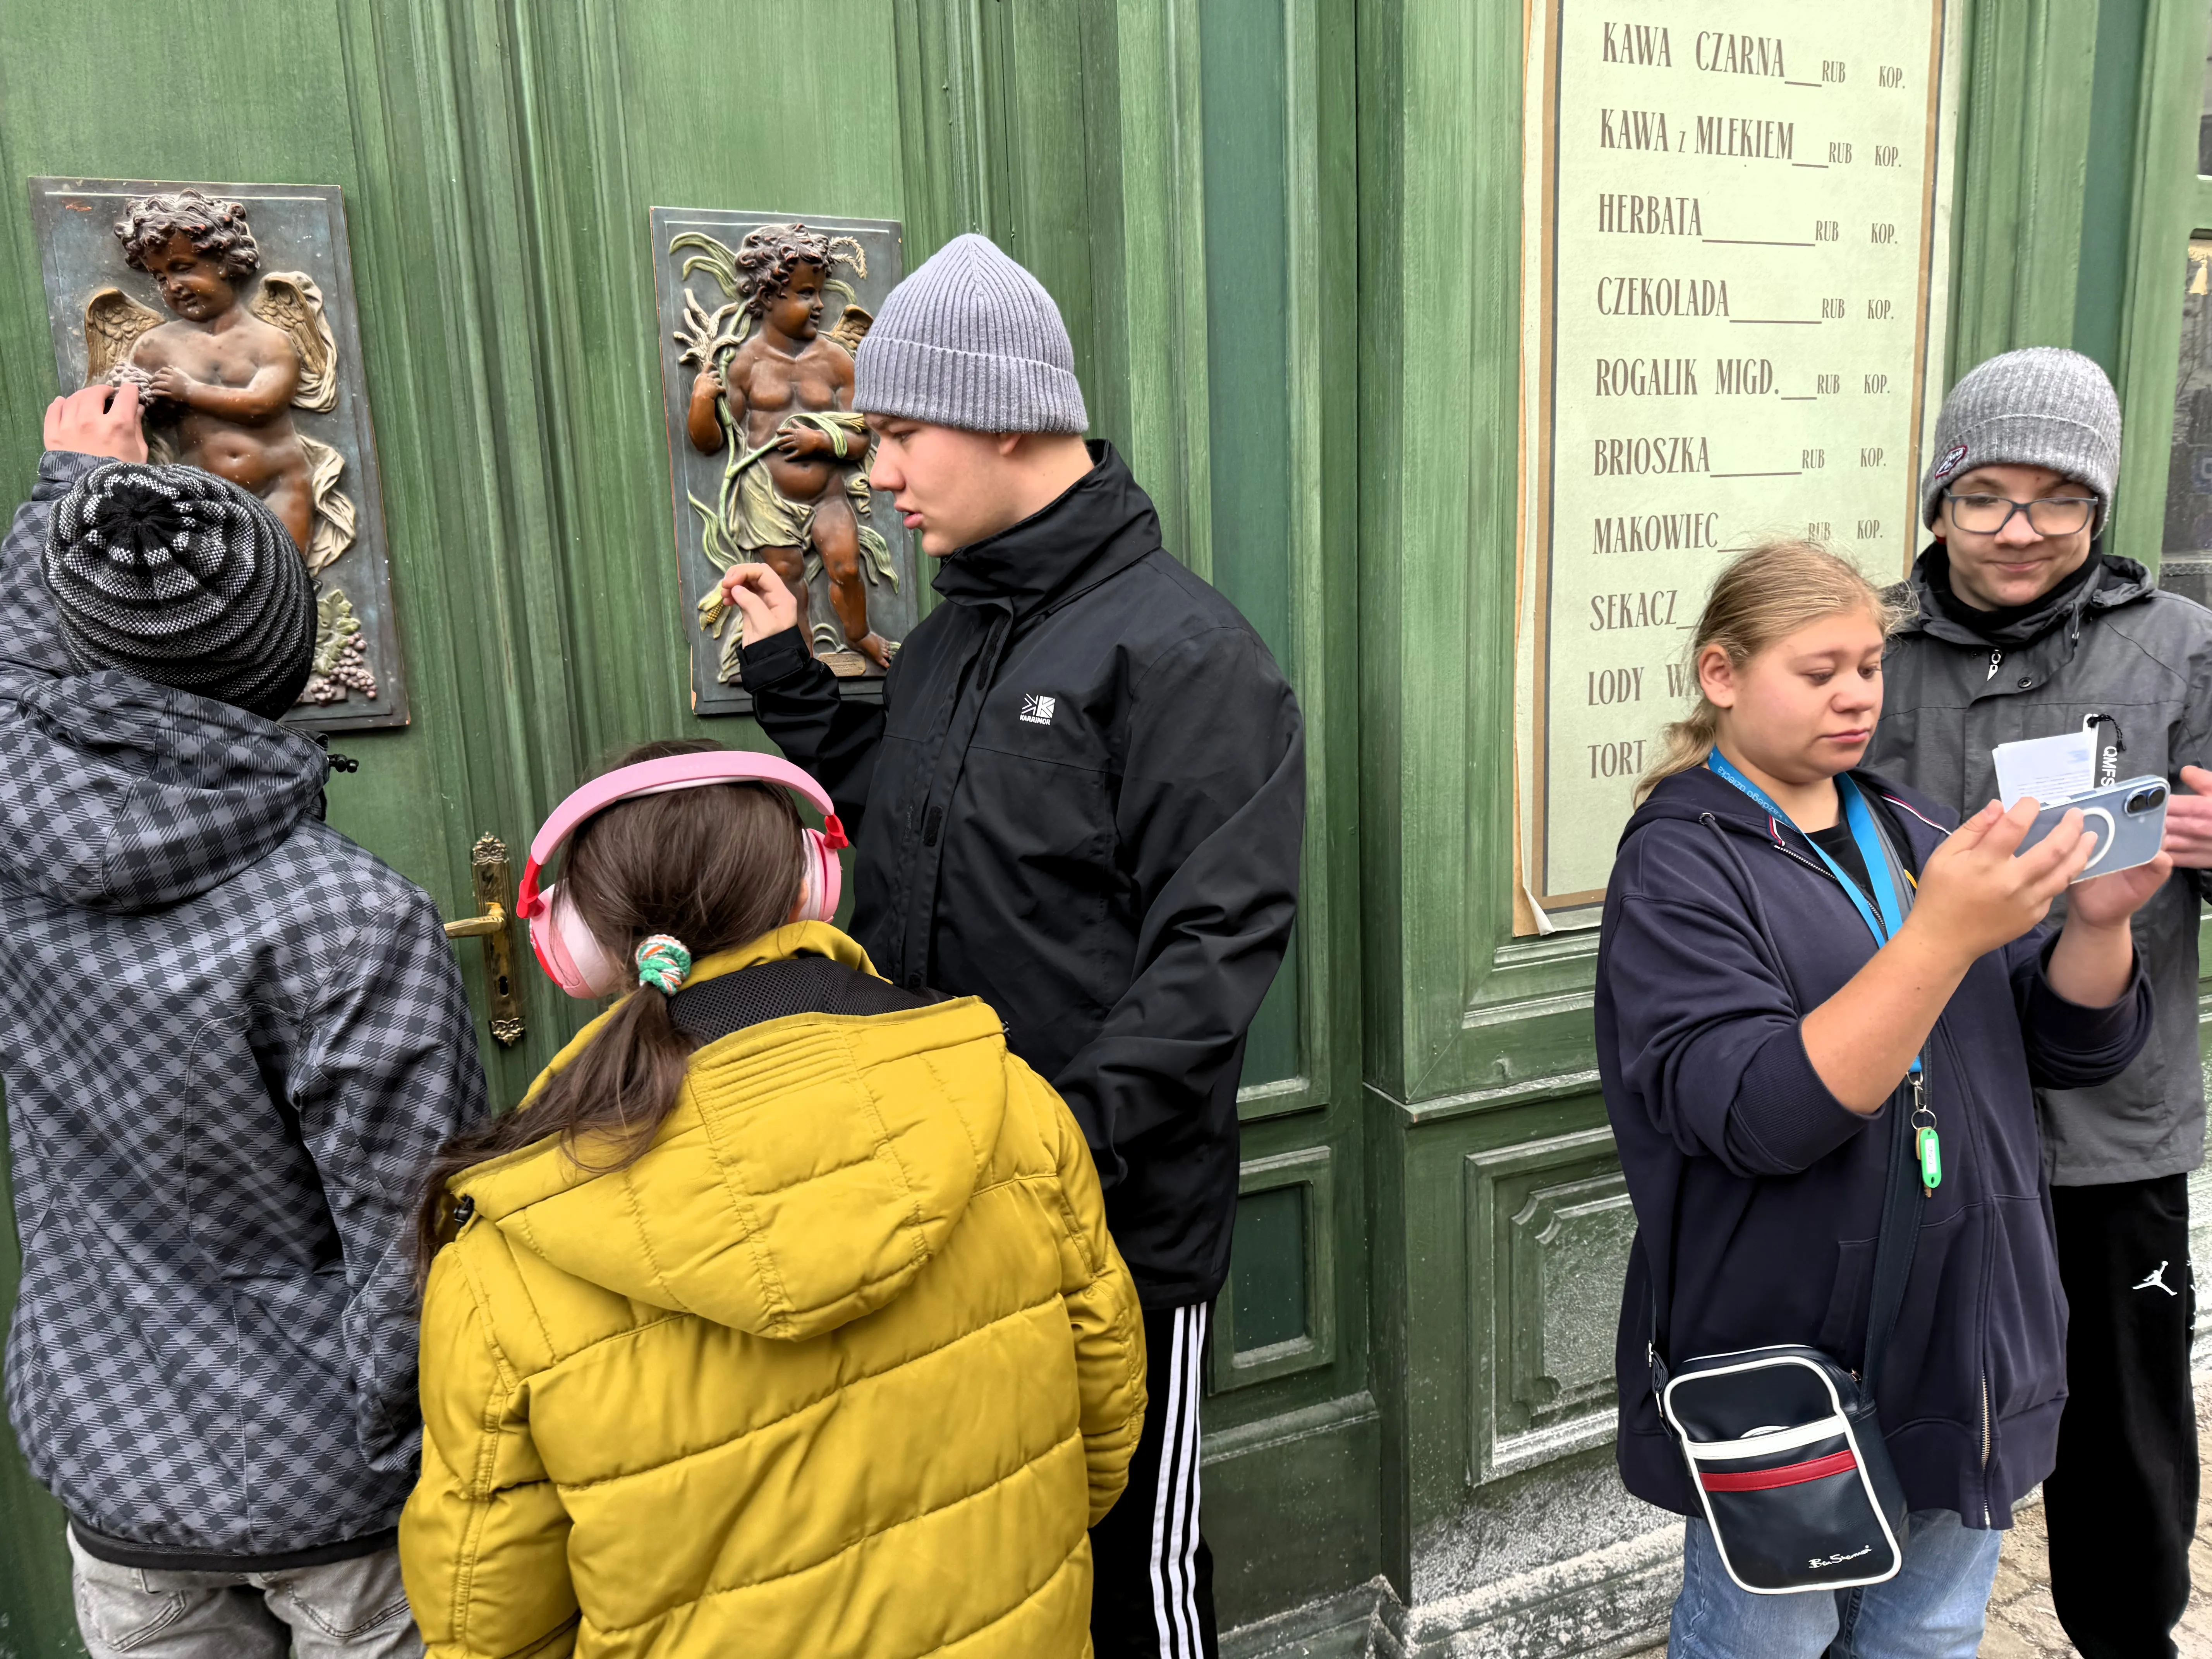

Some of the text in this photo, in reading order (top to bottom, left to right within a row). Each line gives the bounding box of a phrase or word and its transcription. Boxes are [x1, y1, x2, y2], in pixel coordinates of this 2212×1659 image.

[1602, 22, 1905, 88] KAWA CZARNA RUB KOP.
[1600, 108, 1669, 152] KAWA
[1694, 115, 1794, 160] MLEKIEM
[1828, 142, 1852, 164] RUB
[1875, 145, 1901, 167] KOP.
[1599, 193, 1898, 244] HERBATA RUB KOP.
[1597, 276, 1894, 320] CZEKOLADA RUB KOP.
[1595, 358, 1890, 396] ROGALIK MIGD. RUB KOP.
[1594, 436, 1886, 476] BRIOSZKA RUB KOP.
[1592, 512, 1883, 555] MAKOWIEC RUB KOP.
[1590, 590, 1678, 631] SEKACZ
[1588, 666, 1645, 706] LODY
[1019, 714, 1051, 726] KARRIMOR
[1588, 739, 1647, 779] TORT
[1808, 1558, 1832, 1568] Ben
